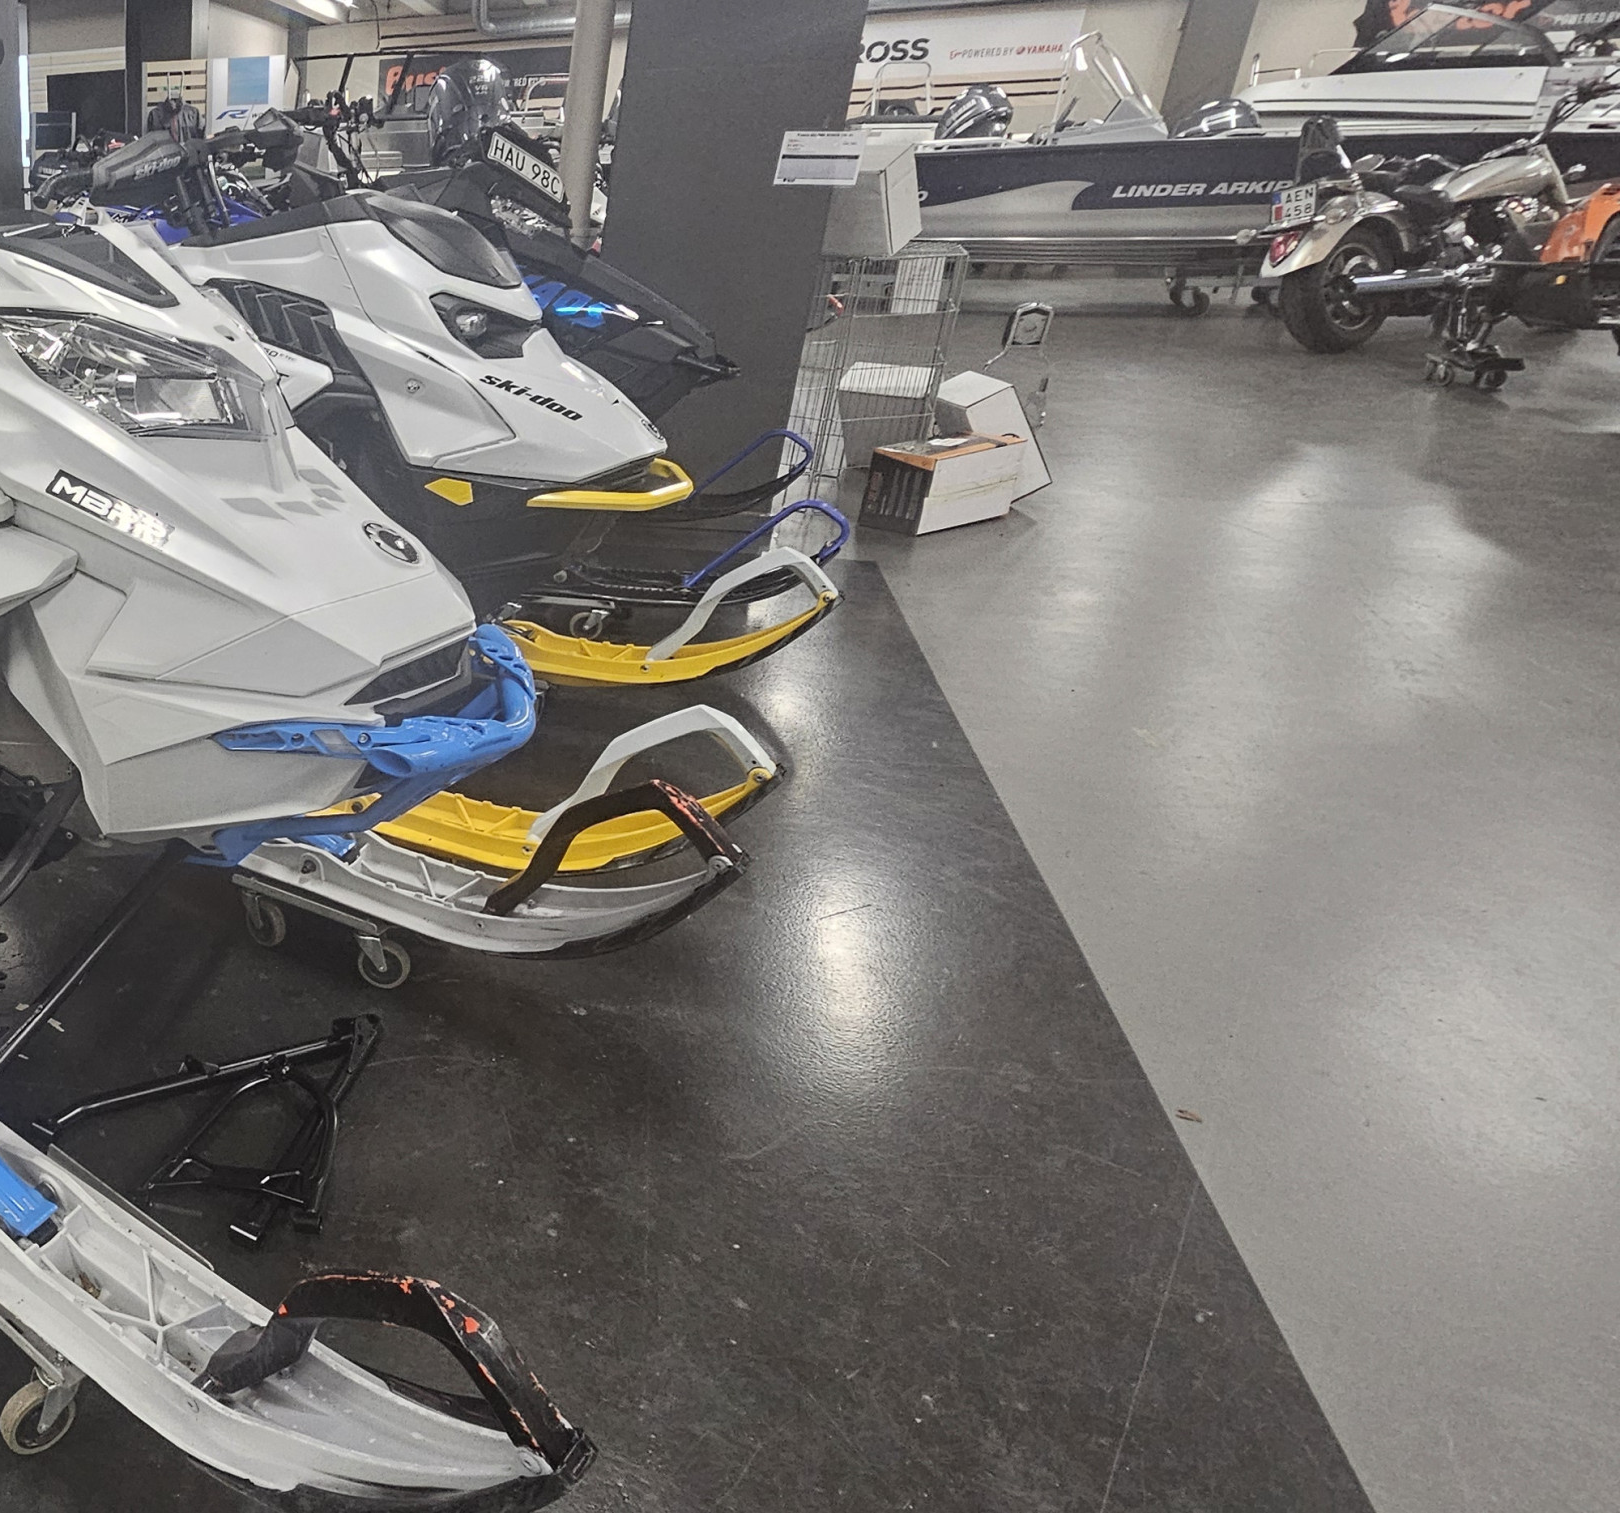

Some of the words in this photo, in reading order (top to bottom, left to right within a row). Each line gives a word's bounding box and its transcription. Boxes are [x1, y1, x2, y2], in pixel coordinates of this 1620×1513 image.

[860, 38, 930, 63] OSS
[961, 47, 1001, 58] POWERED
[1027, 43, 1063, 54] YAMAHA
[494, 139, 526, 171] HAU
[532, 163, 560, 194] 98C
[1112, 183, 1208, 198] LINDER
[479, 375, 583, 421] ski-doo
